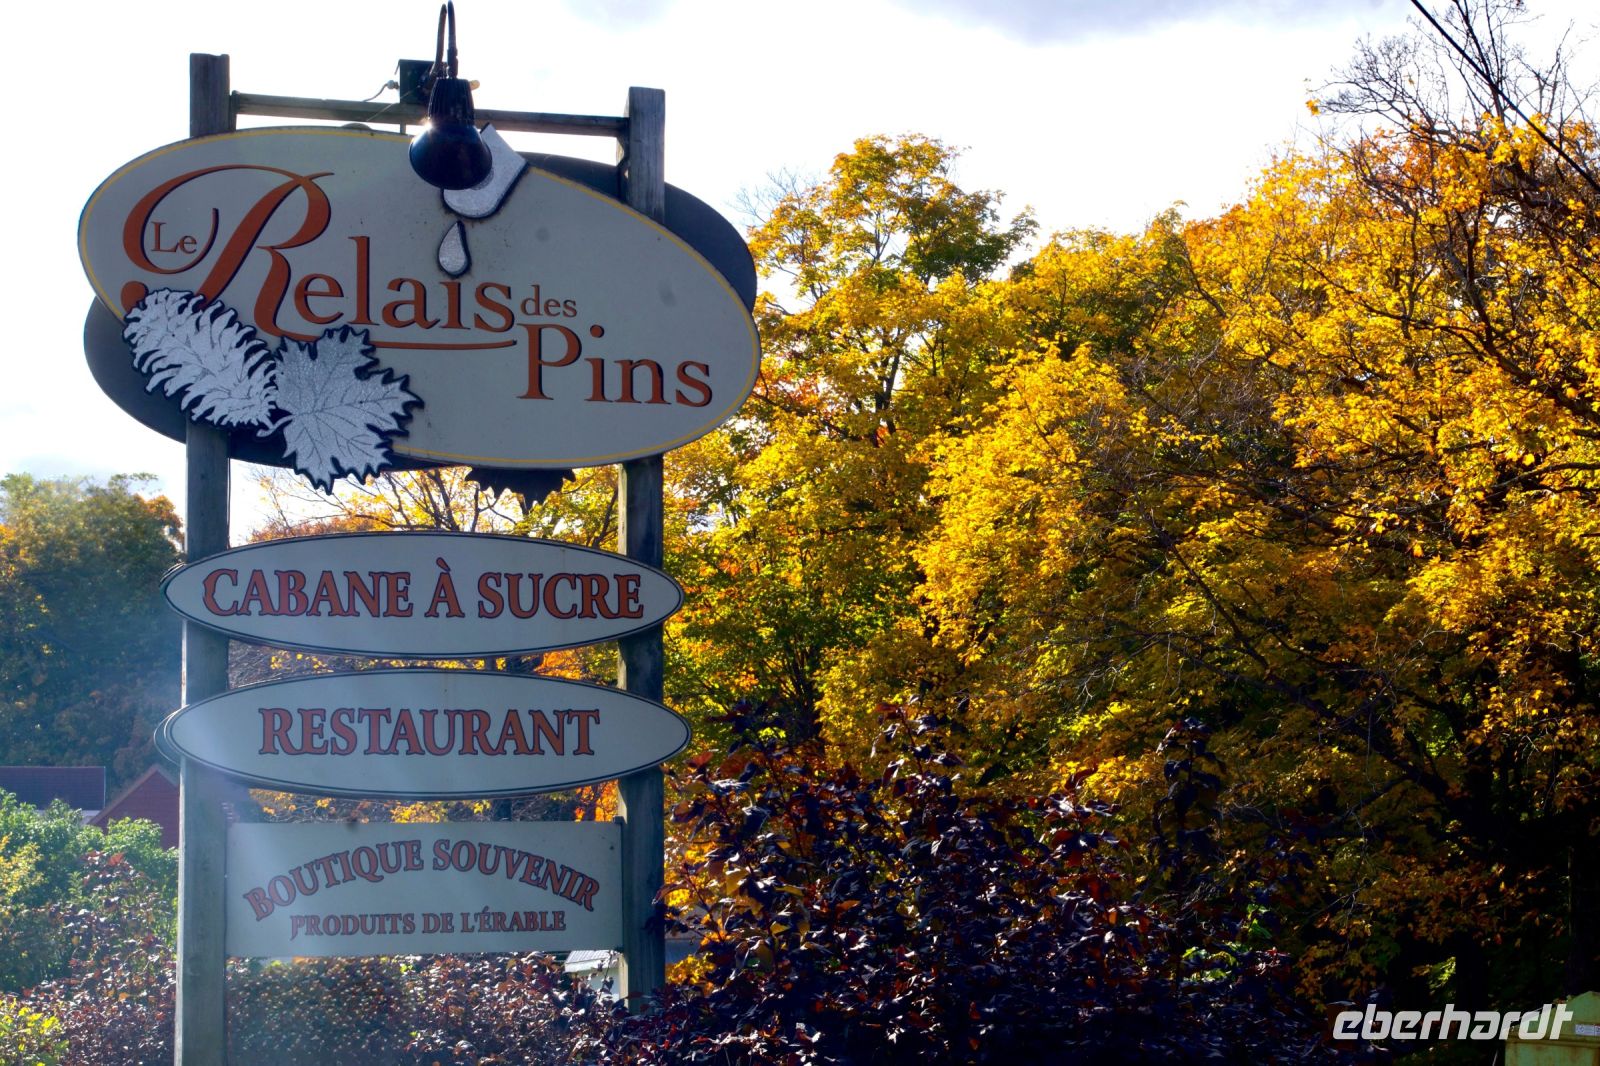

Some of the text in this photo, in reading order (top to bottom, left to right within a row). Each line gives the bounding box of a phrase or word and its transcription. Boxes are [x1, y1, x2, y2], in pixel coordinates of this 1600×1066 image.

[122, 164, 578, 349] Le Relais des
[517, 322, 713, 408] Pins
[203, 557, 644, 619] CABANE À SUCRE
[258, 708, 600, 756] RESTAURANT
[243, 839, 600, 921] BOUTIQUE SOUVENIR
[290, 906, 567, 941] PRODUITS DE L'ÉRABLE
